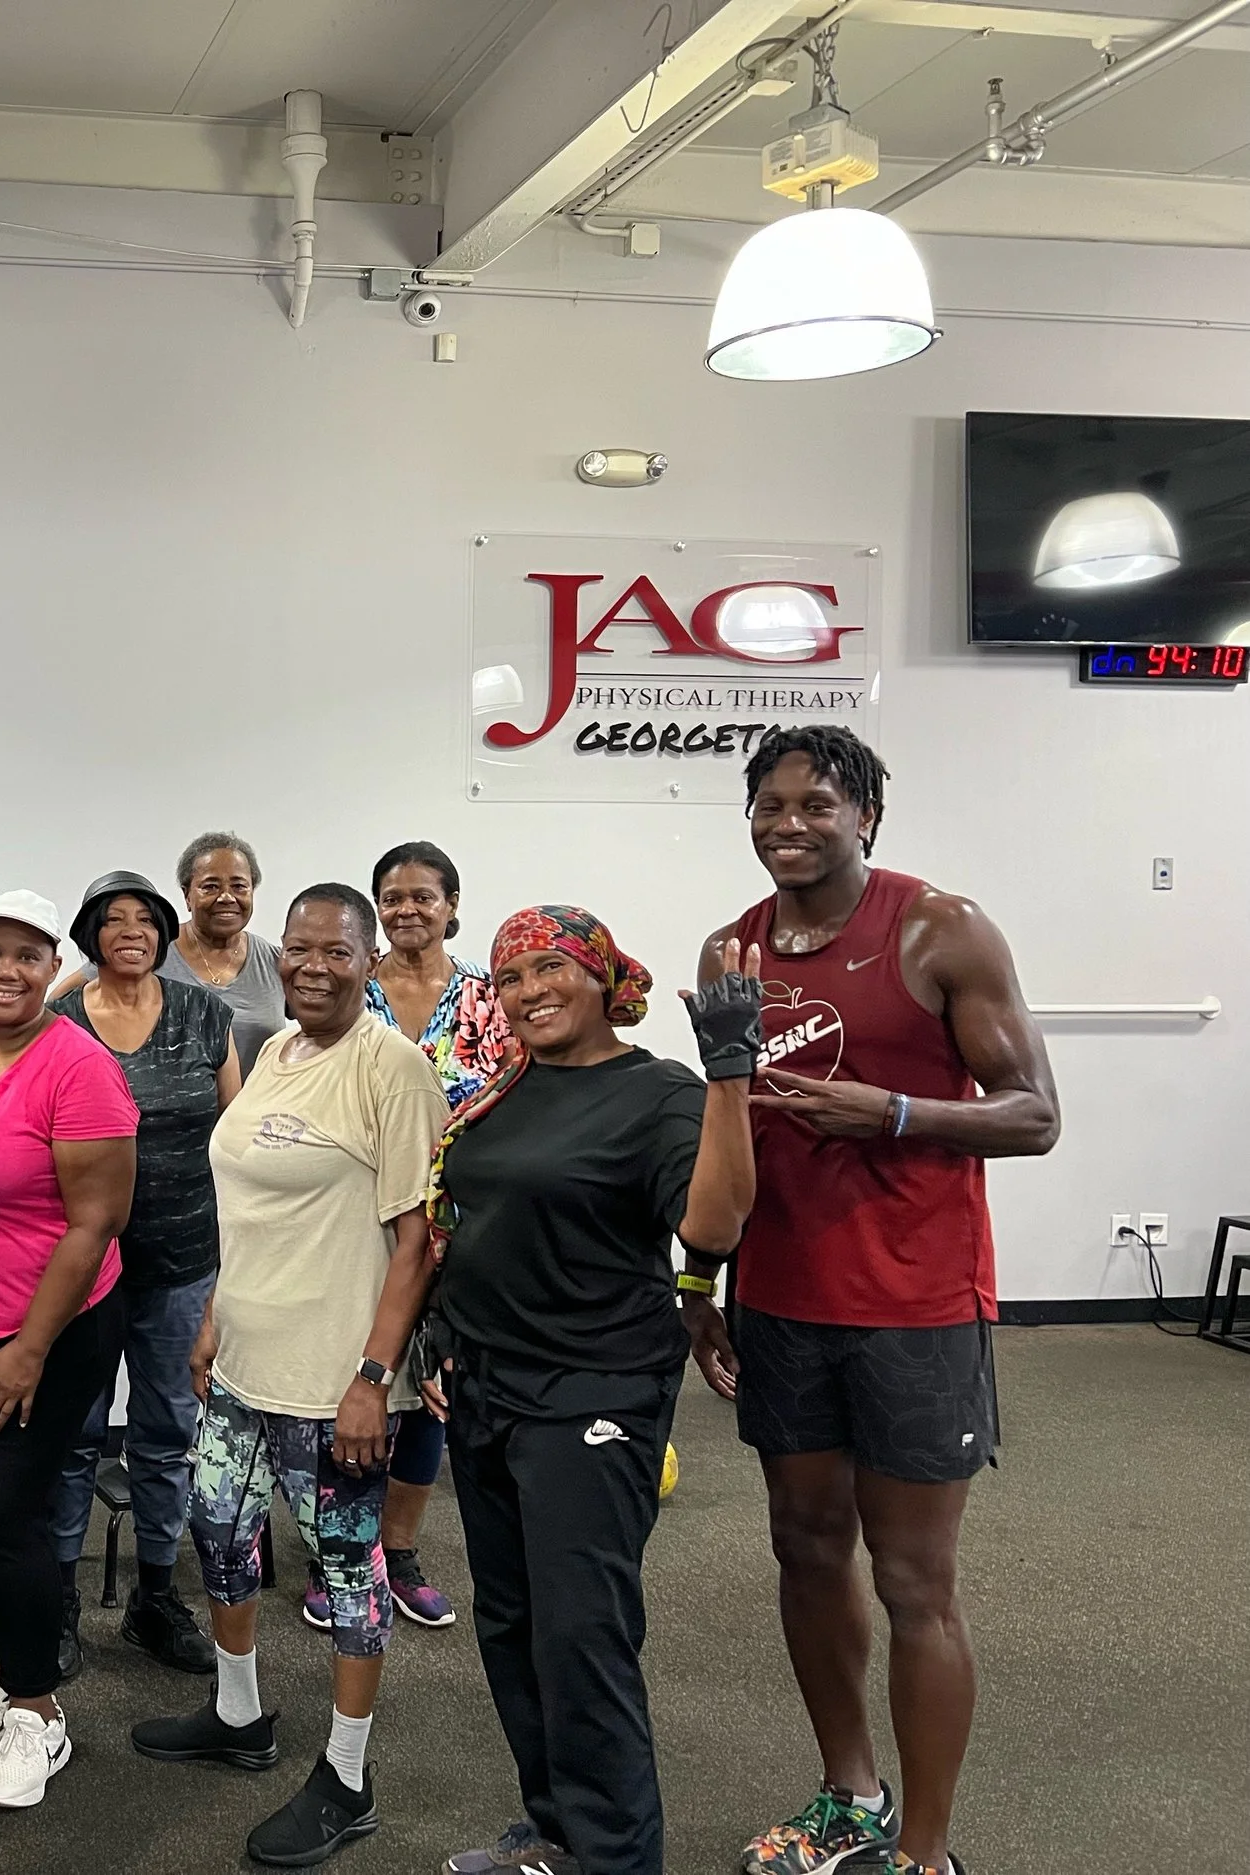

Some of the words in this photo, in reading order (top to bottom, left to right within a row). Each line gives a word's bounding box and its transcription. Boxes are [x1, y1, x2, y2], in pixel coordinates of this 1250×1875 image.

[486, 572, 865, 748] JAG
[576, 686, 723, 708] PHYSICAL
[725, 688, 866, 710] THERAPY
